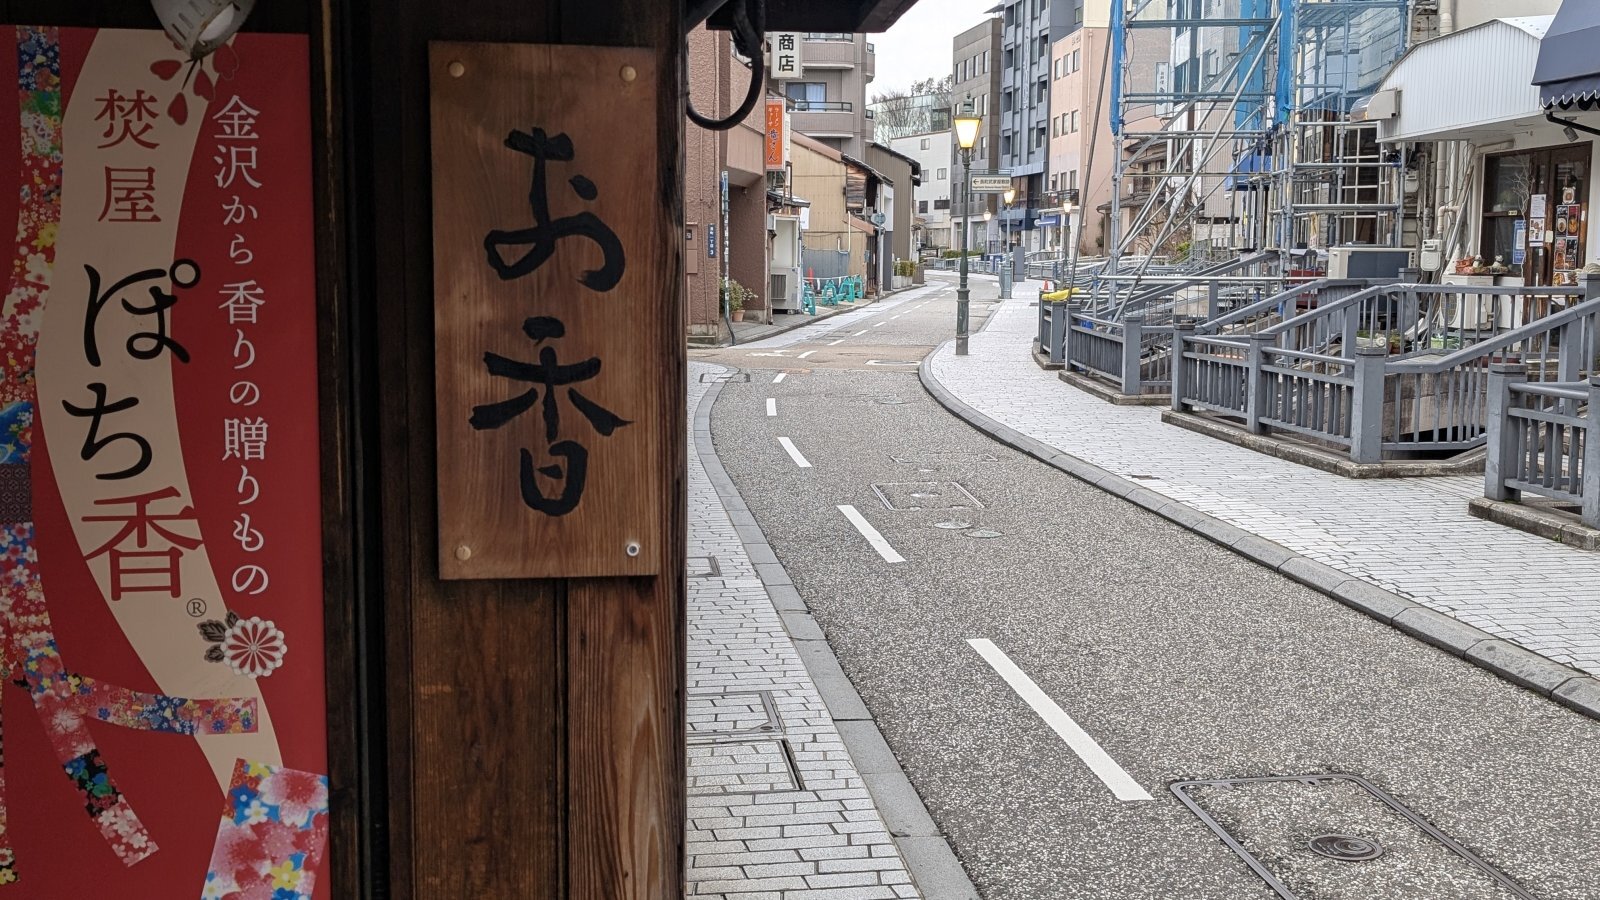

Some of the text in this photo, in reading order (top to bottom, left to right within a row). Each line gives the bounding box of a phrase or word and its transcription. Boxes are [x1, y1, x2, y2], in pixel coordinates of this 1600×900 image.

[94, 89, 161, 223] 焚屋
[778, 33, 795, 72] 商店
[62, 258, 205, 601] ぽち香
[212, 95, 269, 595] 金沢から香りの贈りもの
[470, 126, 635, 518] お香
